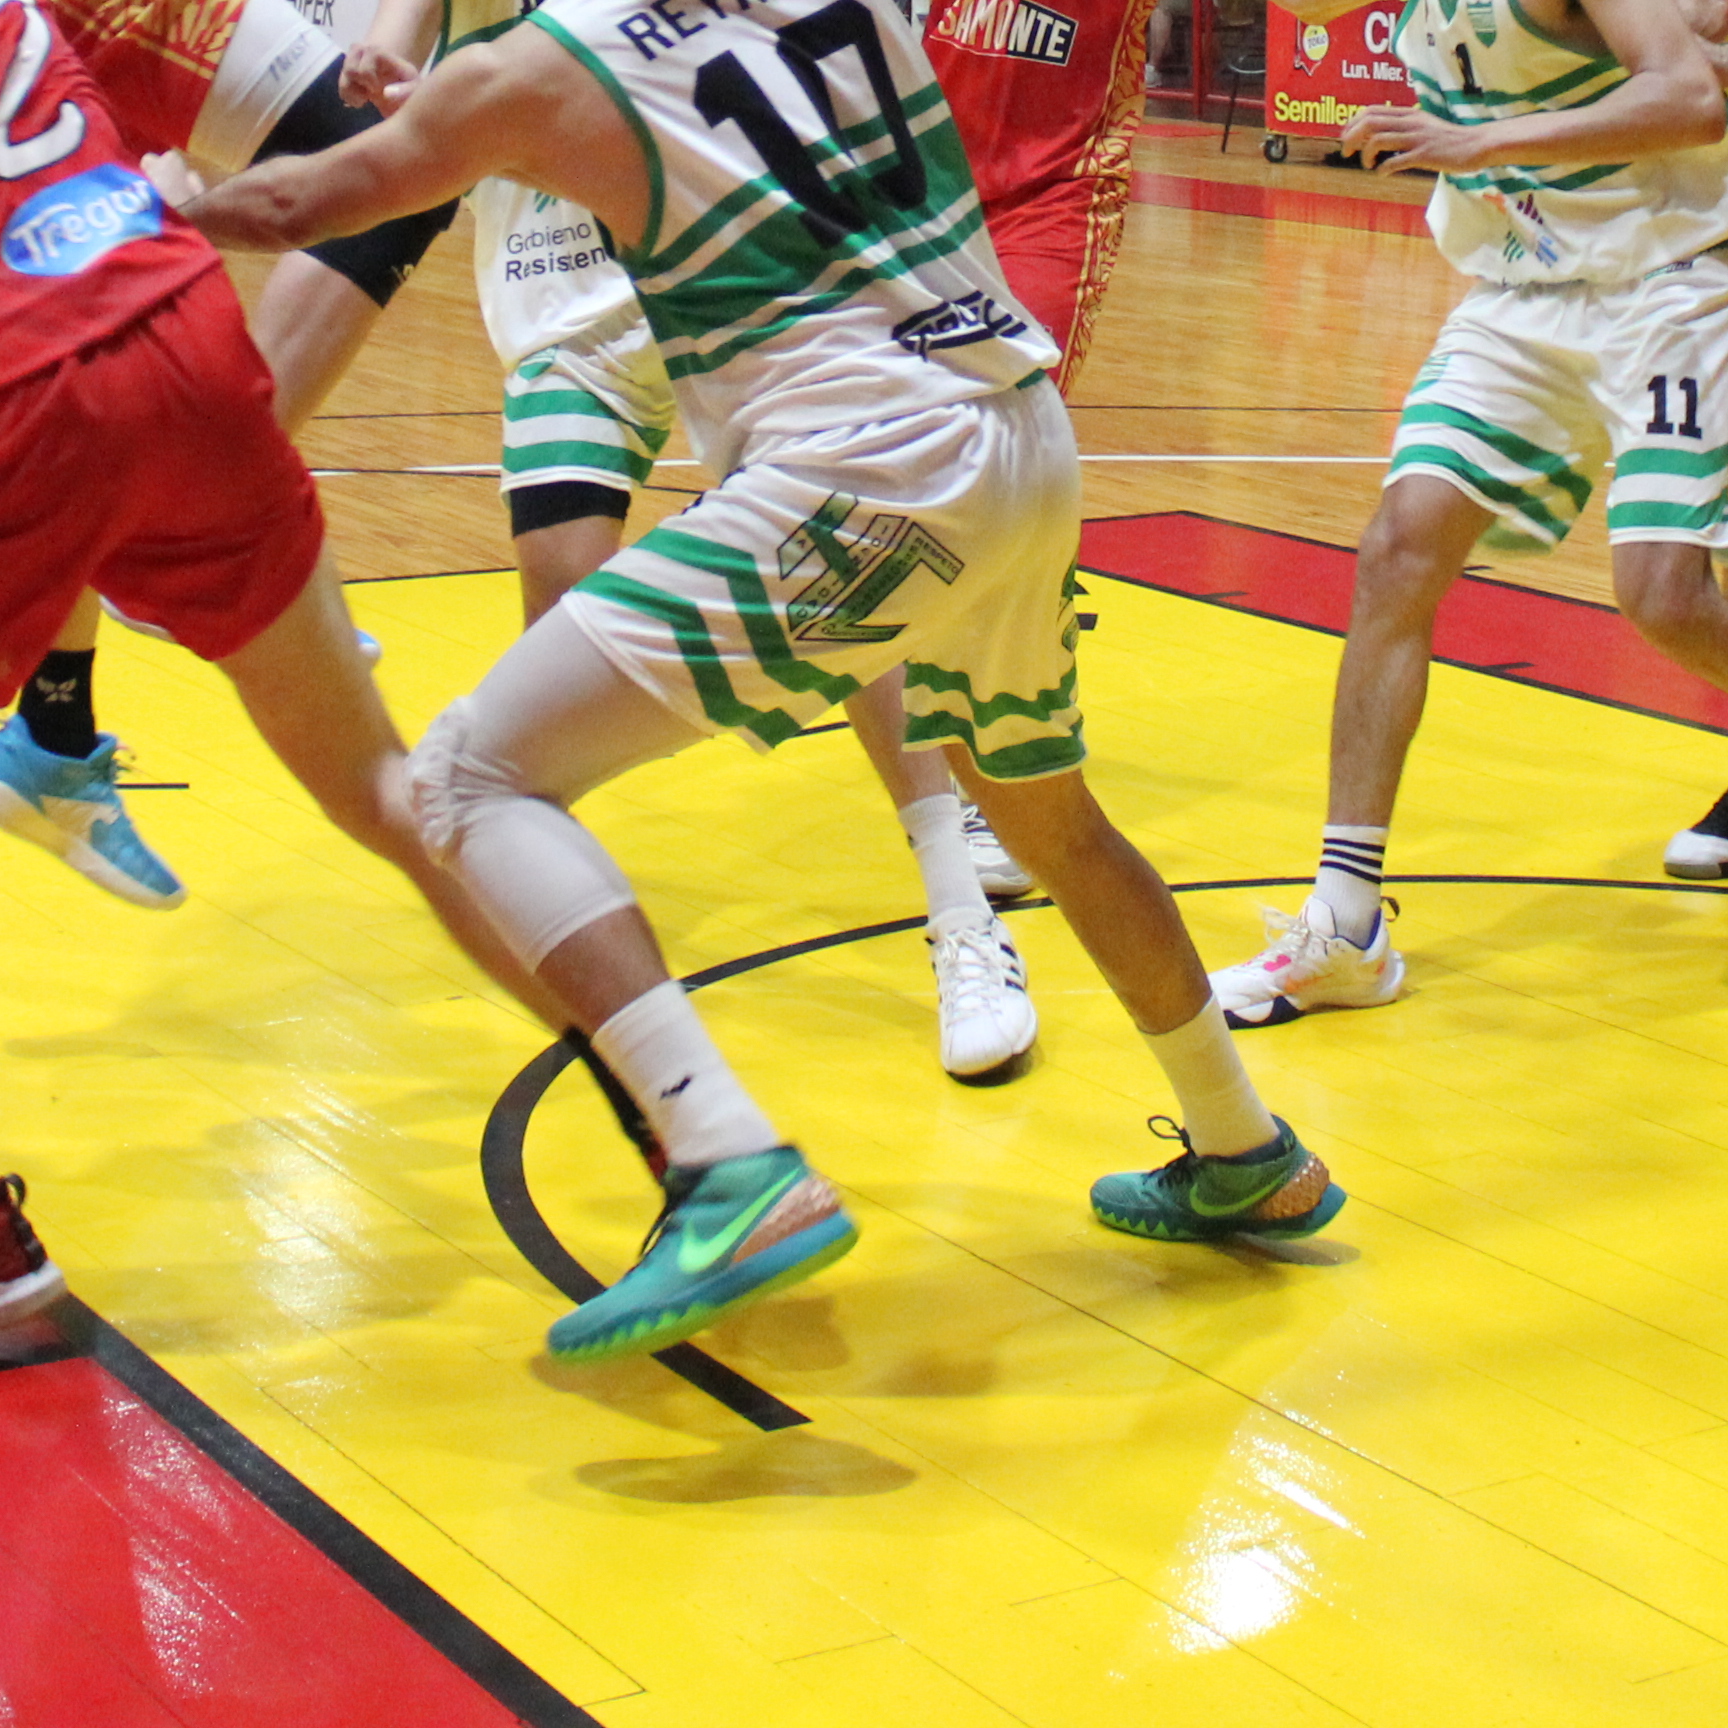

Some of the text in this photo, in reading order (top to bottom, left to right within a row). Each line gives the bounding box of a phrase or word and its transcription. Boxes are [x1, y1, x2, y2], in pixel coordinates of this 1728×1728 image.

[1341, 59, 1371, 79] Lun.
[1373, 61, 1404, 82] Mier.
[505, 246, 607, 283] Resisten
[1646, 374, 1703, 440] 11
